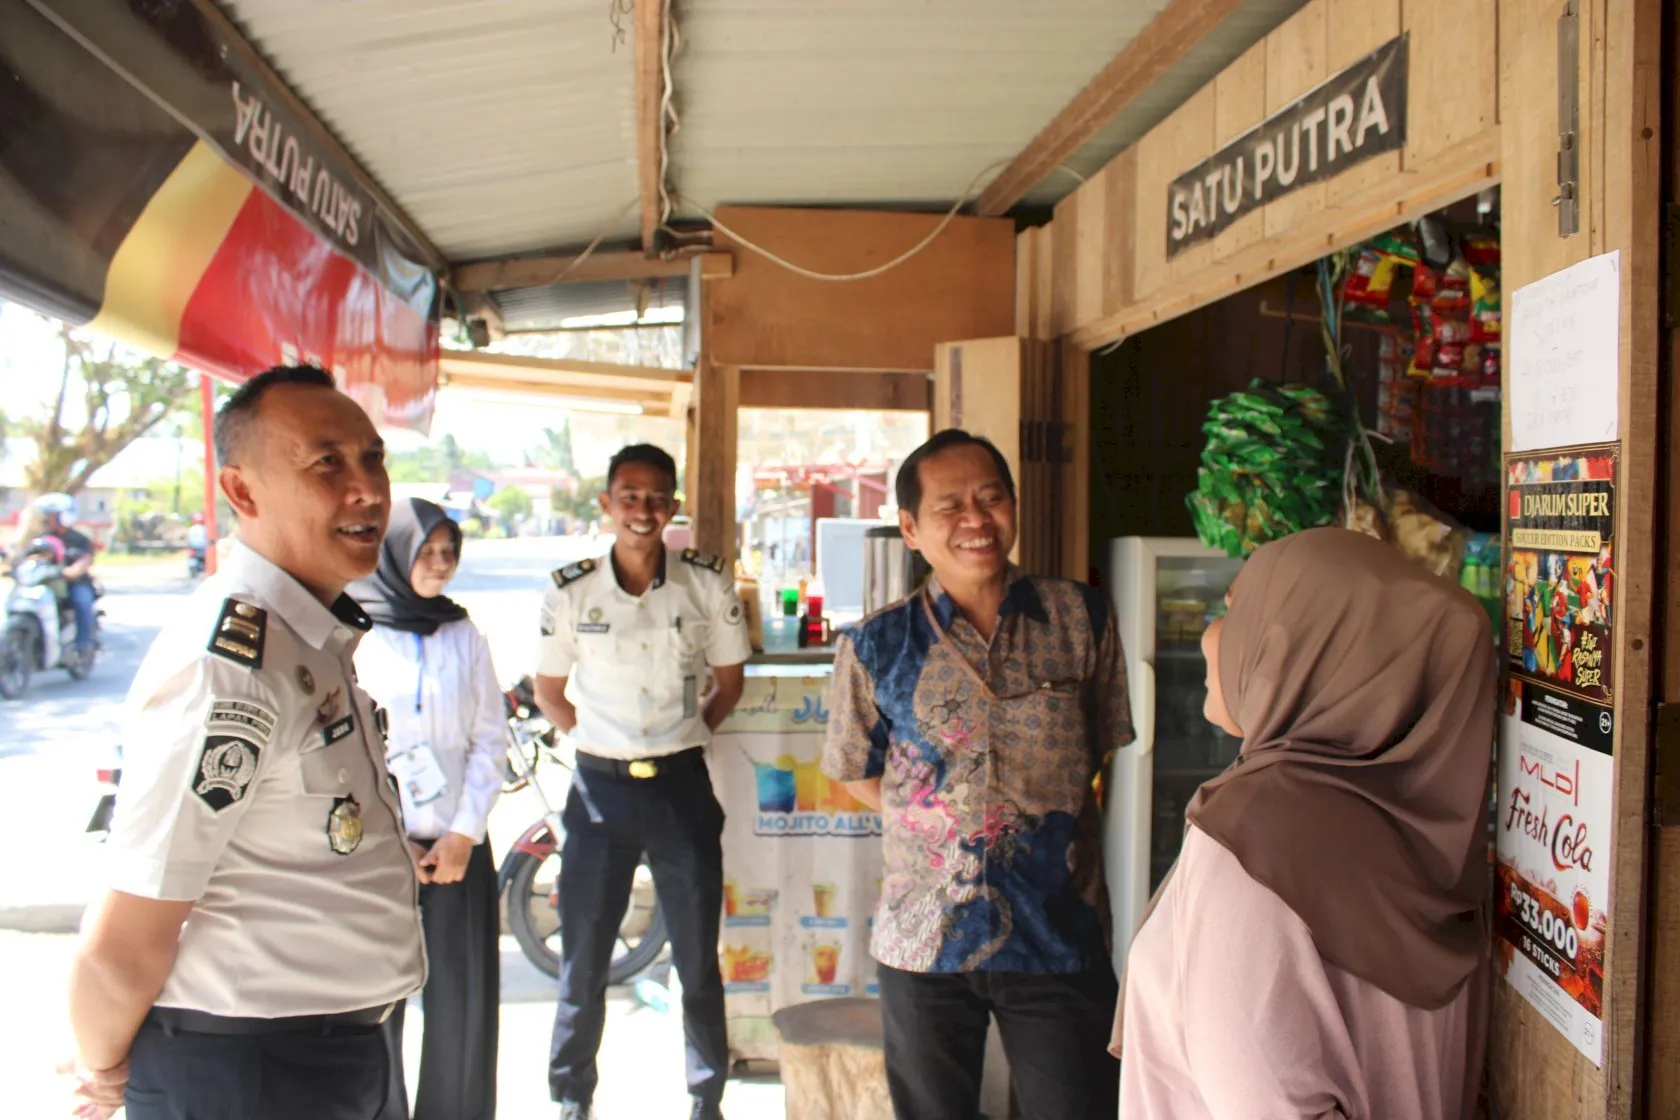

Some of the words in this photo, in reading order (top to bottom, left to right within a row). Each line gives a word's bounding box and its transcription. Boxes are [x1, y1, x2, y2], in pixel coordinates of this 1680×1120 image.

[232, 81, 314, 203] PUTRA
[1172, 156, 1244, 240] SATU
[1254, 73, 1389, 199] PUTRA
[312, 168, 361, 246] SATU
[1524, 494, 1566, 518] DJARUM
[1567, 492, 1610, 516] SUPER
[1515, 532, 1540, 544] SOCCER
[1540, 533, 1568, 546] EDITION
[1570, 534, 1596, 548] PACKS
[1575, 666, 1601, 687] SUPER
[758, 815, 829, 831] MOJITO
[1505, 787, 1547, 847] Fresh
[1551, 814, 1593, 872] Cola
[1522, 935, 1532, 951] 16
[1532, 944, 1560, 977] STICKS
